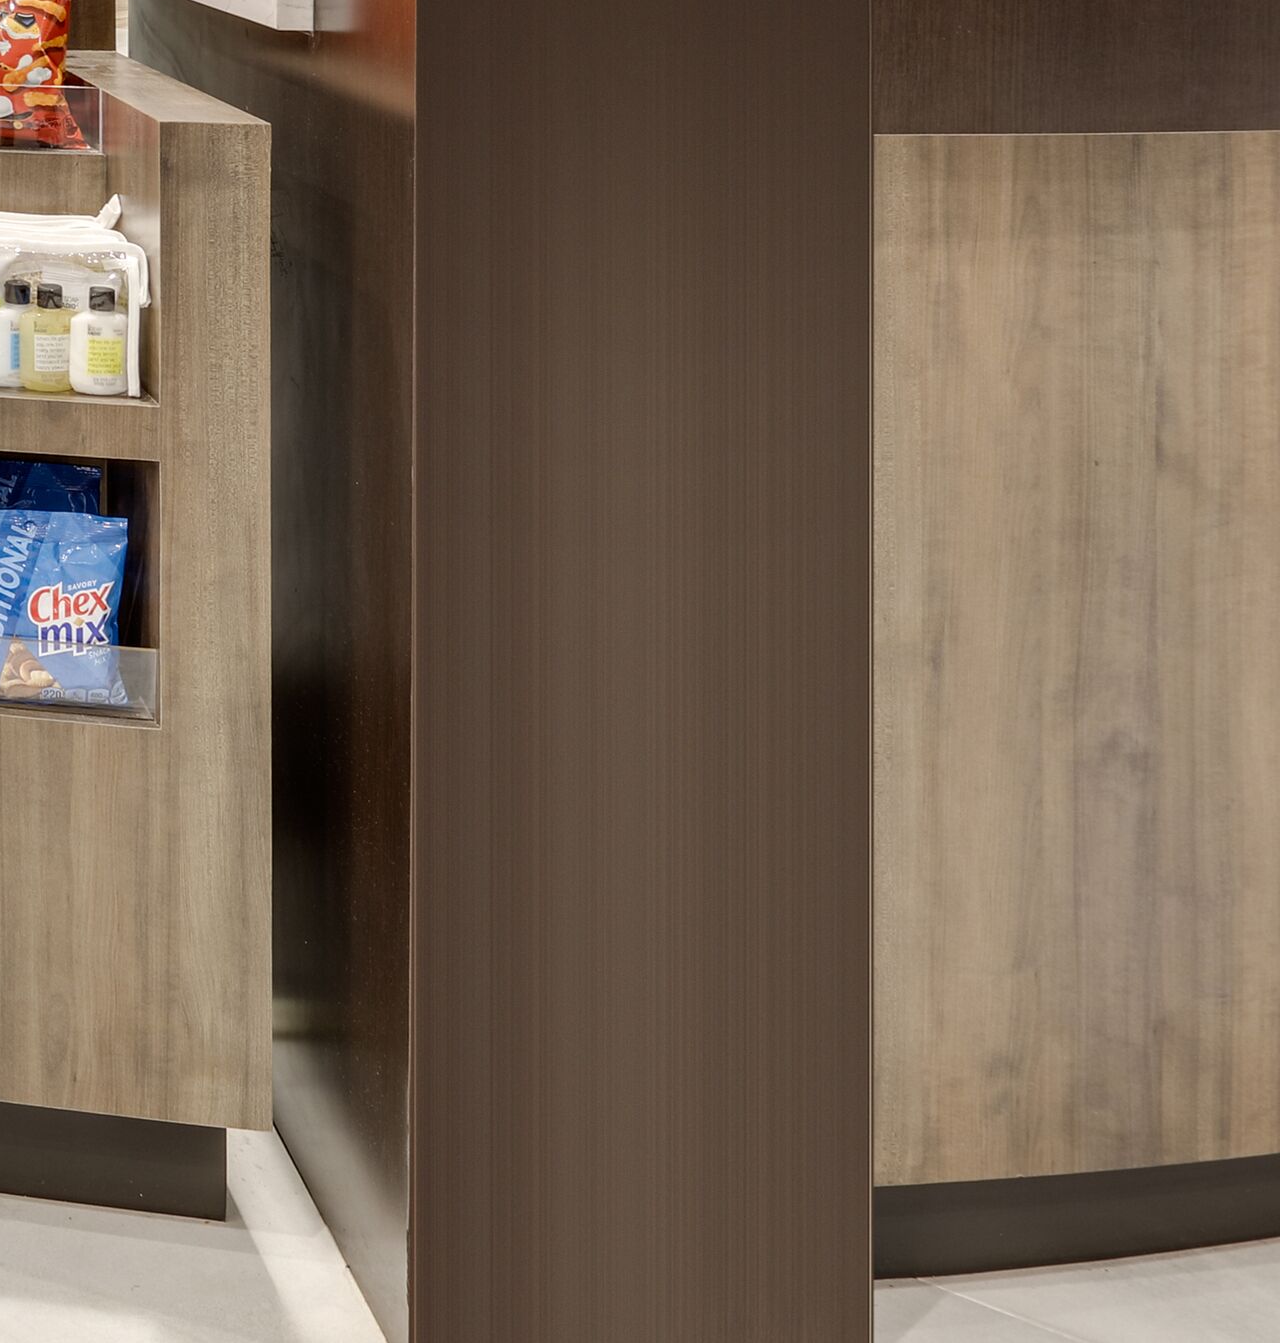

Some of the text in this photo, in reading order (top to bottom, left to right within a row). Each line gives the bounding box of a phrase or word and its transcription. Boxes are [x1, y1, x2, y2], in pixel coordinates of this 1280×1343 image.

[67, 579, 98, 592] SAVORY
[28, 582, 115, 623] Chex
[39, 615, 110, 653] mix
[43, 689, 63, 700] 220
